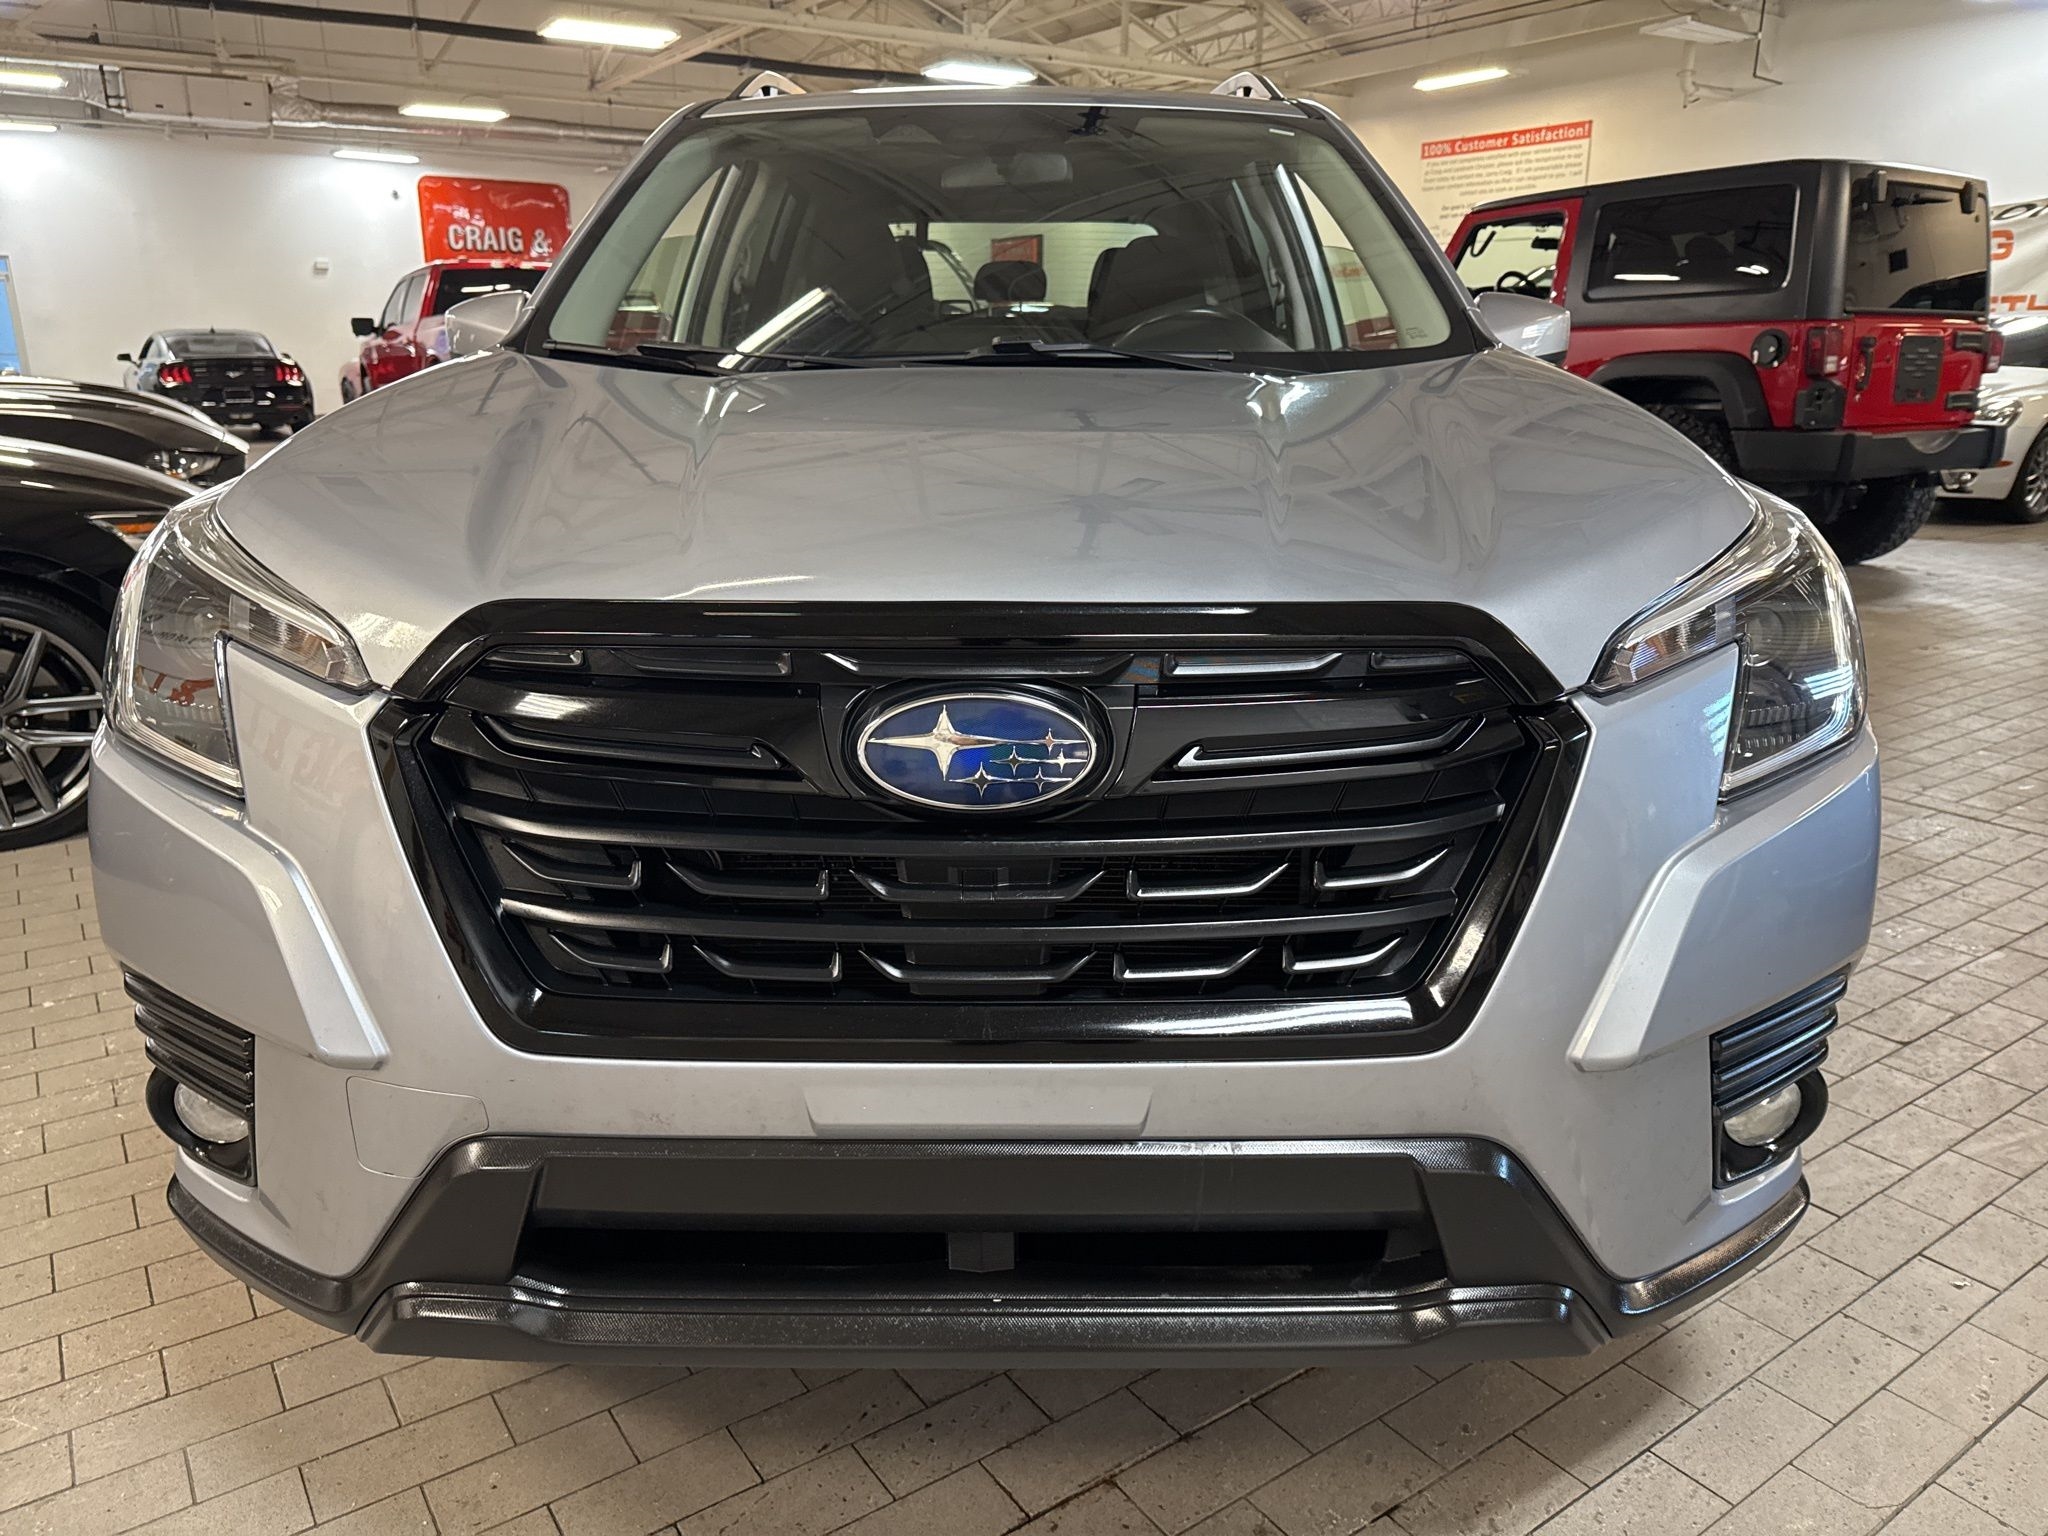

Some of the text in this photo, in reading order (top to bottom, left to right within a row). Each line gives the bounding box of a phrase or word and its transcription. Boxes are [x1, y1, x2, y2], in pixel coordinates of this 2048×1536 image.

[1423, 142, 1451, 157] 100%
[1455, 136, 1508, 153] Customer
[1511, 122, 1589, 146] Satisfaction!
[447, 224, 551, 254] CRAIG &
